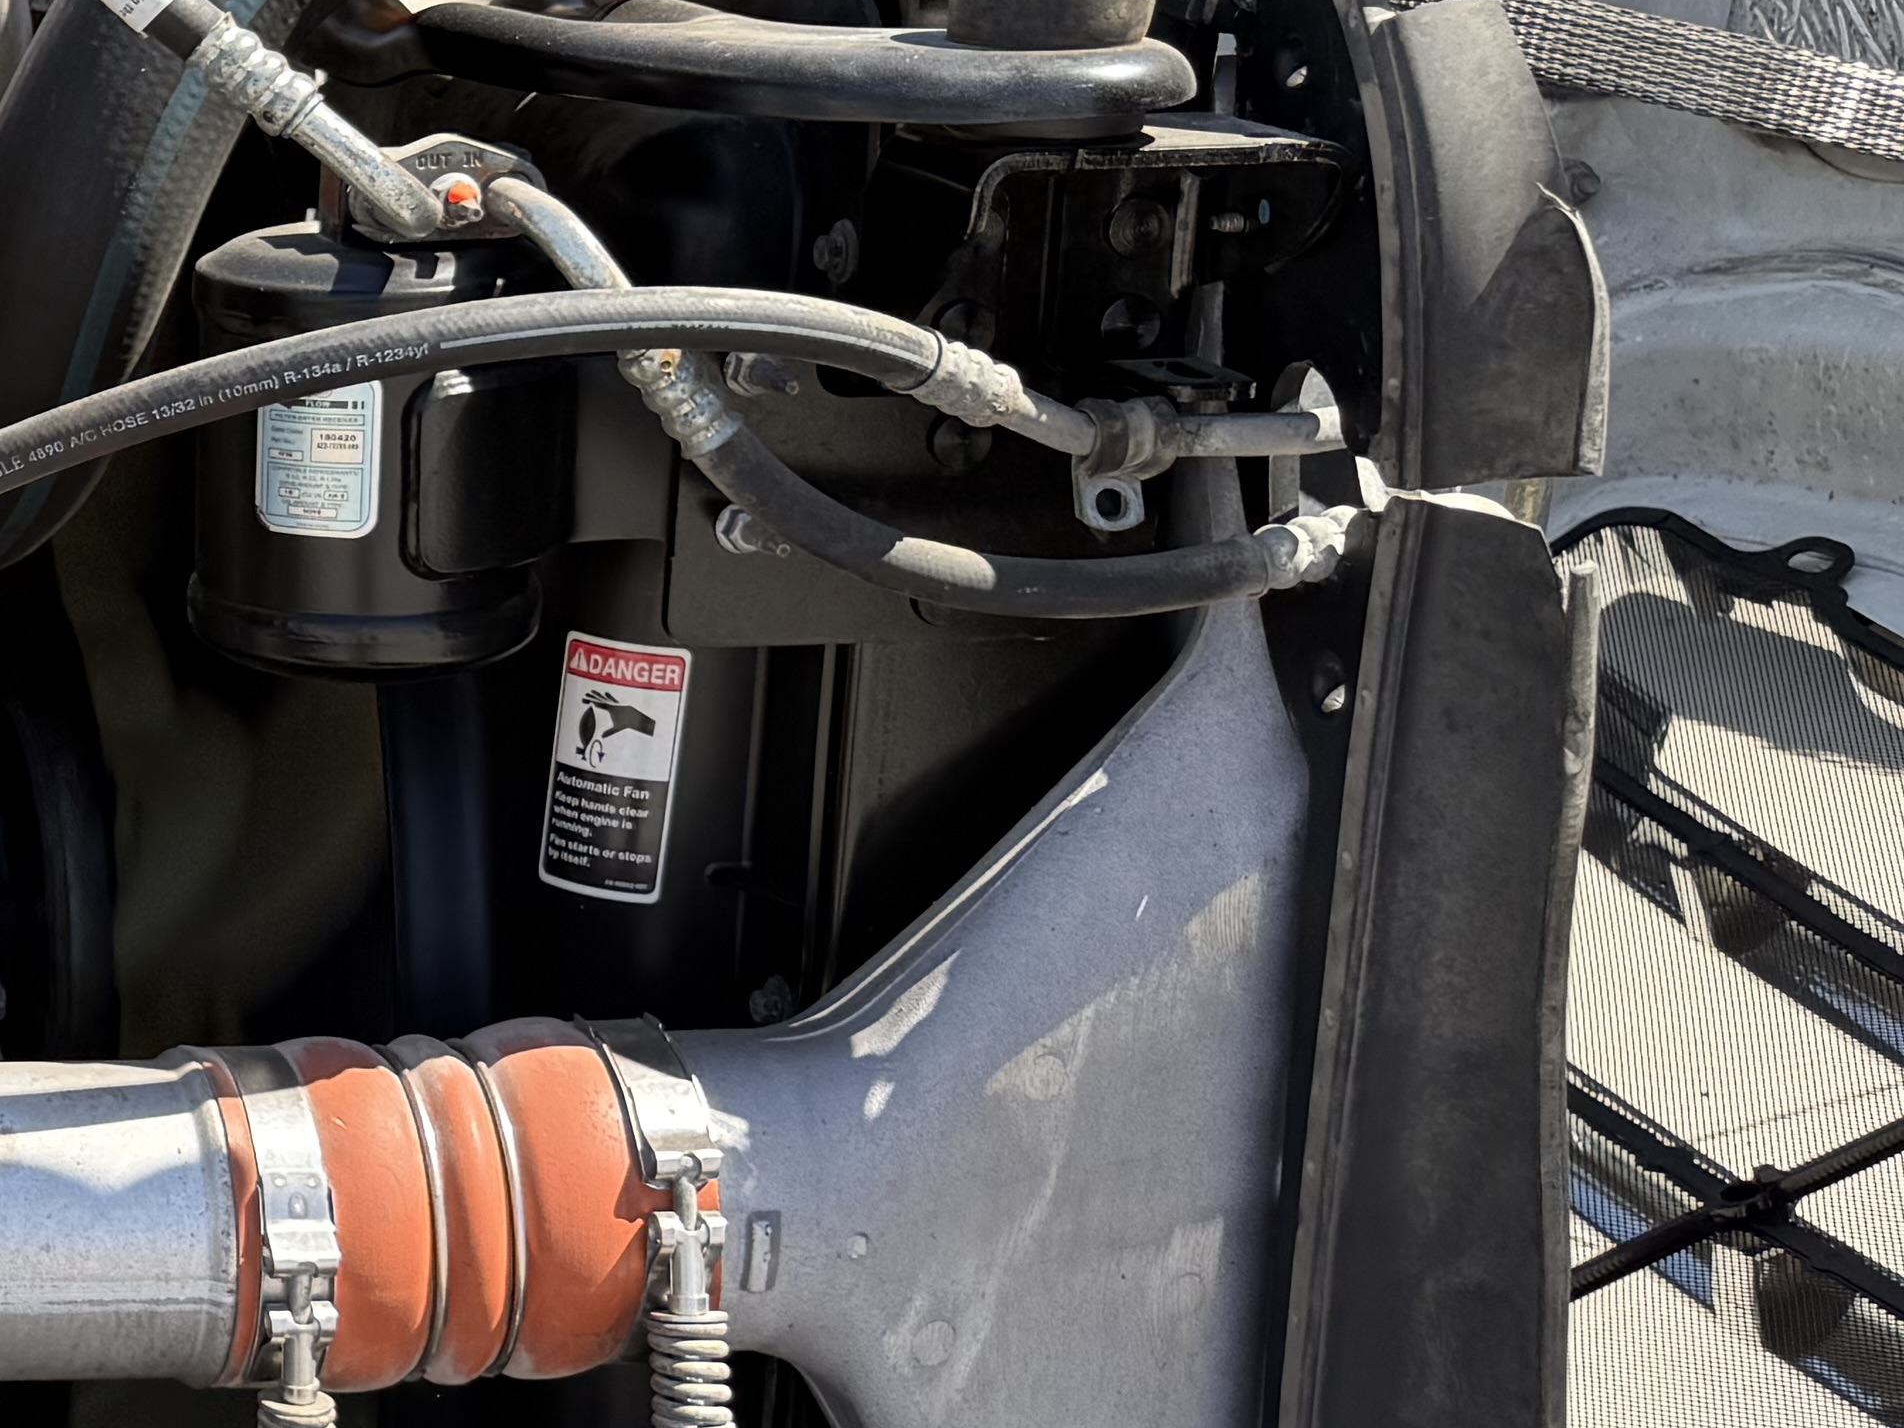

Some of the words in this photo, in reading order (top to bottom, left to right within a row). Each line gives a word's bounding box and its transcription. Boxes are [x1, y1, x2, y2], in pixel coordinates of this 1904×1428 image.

[415, 153, 452, 170] OUT
[462, 151, 483, 168] IN
[70, 429, 97, 449] A/C
[99, 413, 149, 439] HOSE
[152, 398, 196, 421] 13/32
[199, 393, 214, 408] in
[218, 374, 278, 403] (10mm)
[285, 361, 342, 385] R-134a
[356, 343, 429, 369] R-1234yf
[588, 653, 681, 685] DANGER
[556, 771, 619, 797] Automatic
[623, 785, 650, 800] Fan
[553, 804, 578, 819] when
[580, 812, 619, 829] engine
[621, 818, 633, 830] is
[554, 790, 579, 808] Keep
[580, 797, 616, 814] hands
[619, 806, 649, 818] clear
[551, 817, 593, 838] running.
[549, 832, 566, 849] Fan
[567, 839, 600, 857] starts
[602, 848, 616, 859] or
[618, 850, 652, 865] stops
